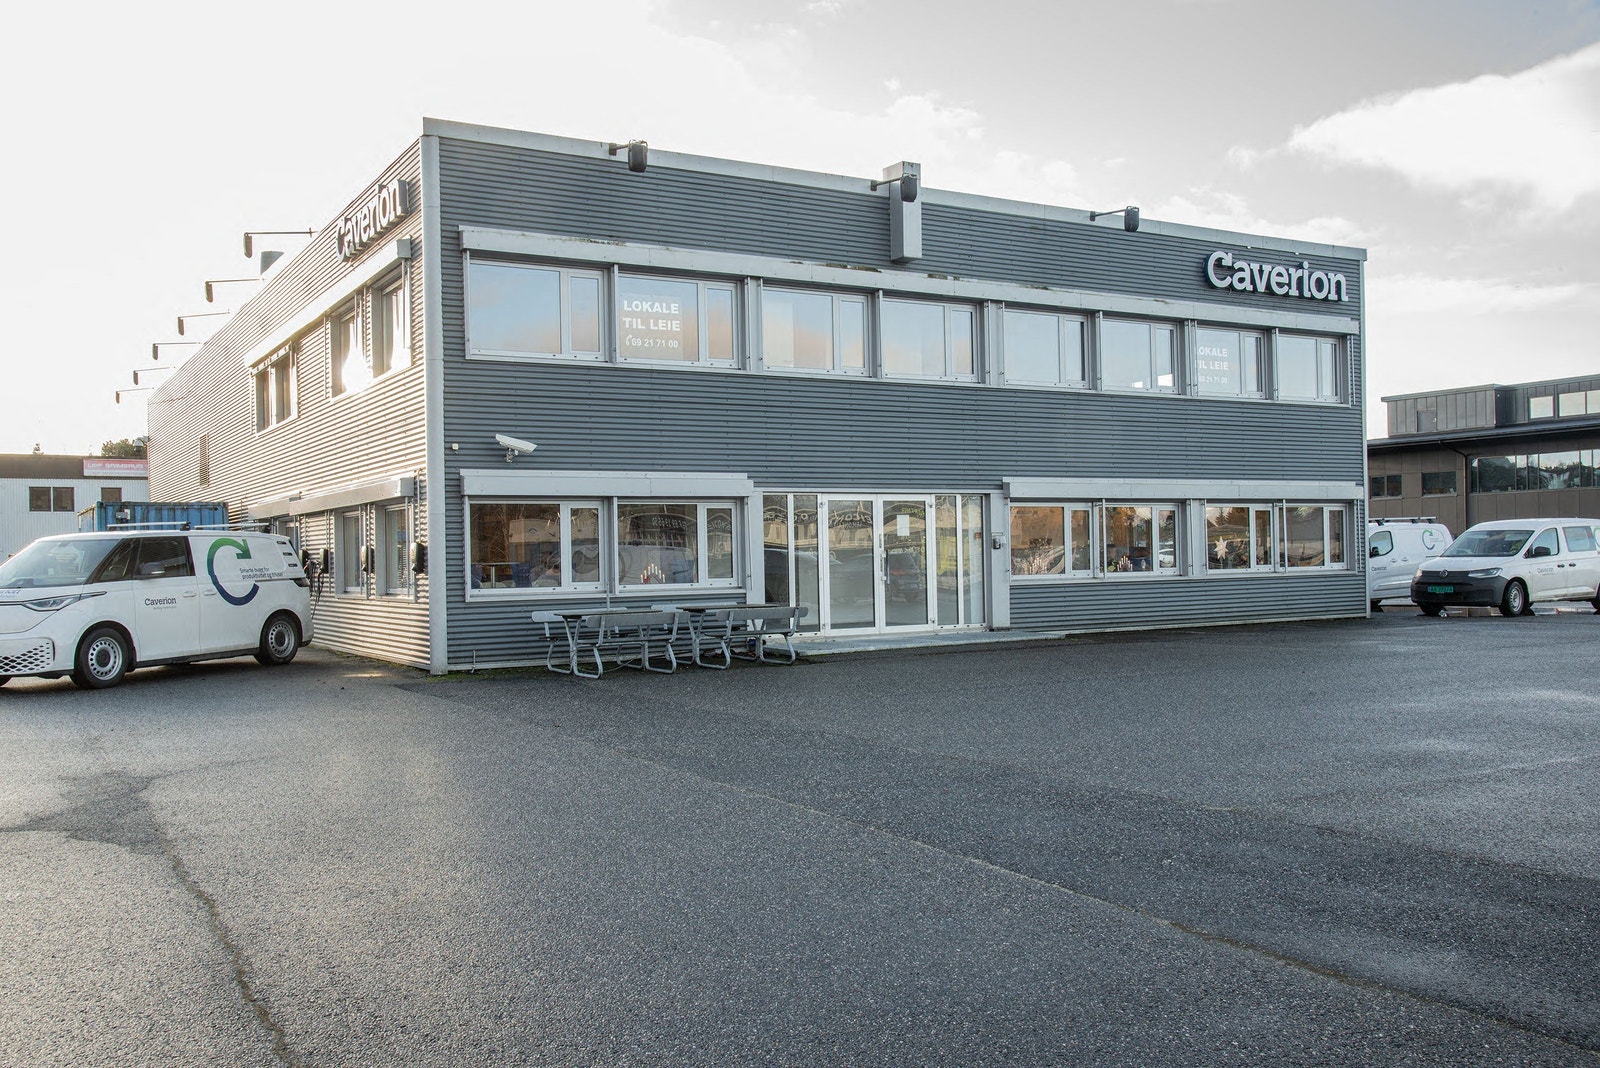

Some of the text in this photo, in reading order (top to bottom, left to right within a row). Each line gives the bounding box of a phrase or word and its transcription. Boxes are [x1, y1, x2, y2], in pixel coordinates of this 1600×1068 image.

[336, 179, 403, 262] Caverion
[1205, 251, 1349, 302] Caverion
[623, 300, 680, 314] LOKALE
[623, 317, 681, 331] TIL LEIE
[644, 338, 654, 347] 21
[656, 339, 666, 347] 71
[1198, 346, 1228, 357] OKALE
[1209, 360, 1229, 371] LEIE
[144, 596, 177, 606] Caverion
